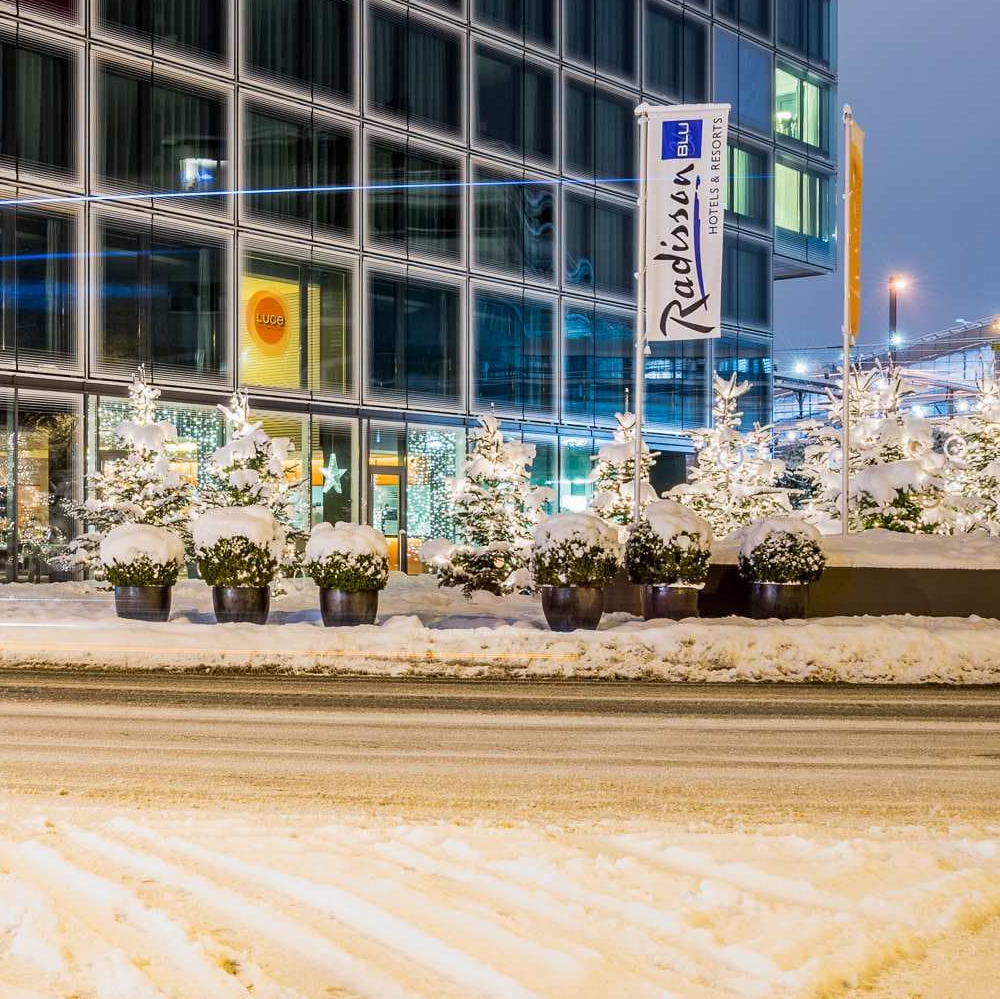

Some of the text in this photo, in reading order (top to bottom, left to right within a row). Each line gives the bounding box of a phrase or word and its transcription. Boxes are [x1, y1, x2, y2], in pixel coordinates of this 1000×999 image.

[653, 122, 716, 337] Radisson BLU
[708, 117, 723, 235] HOTELS & RESORTS
